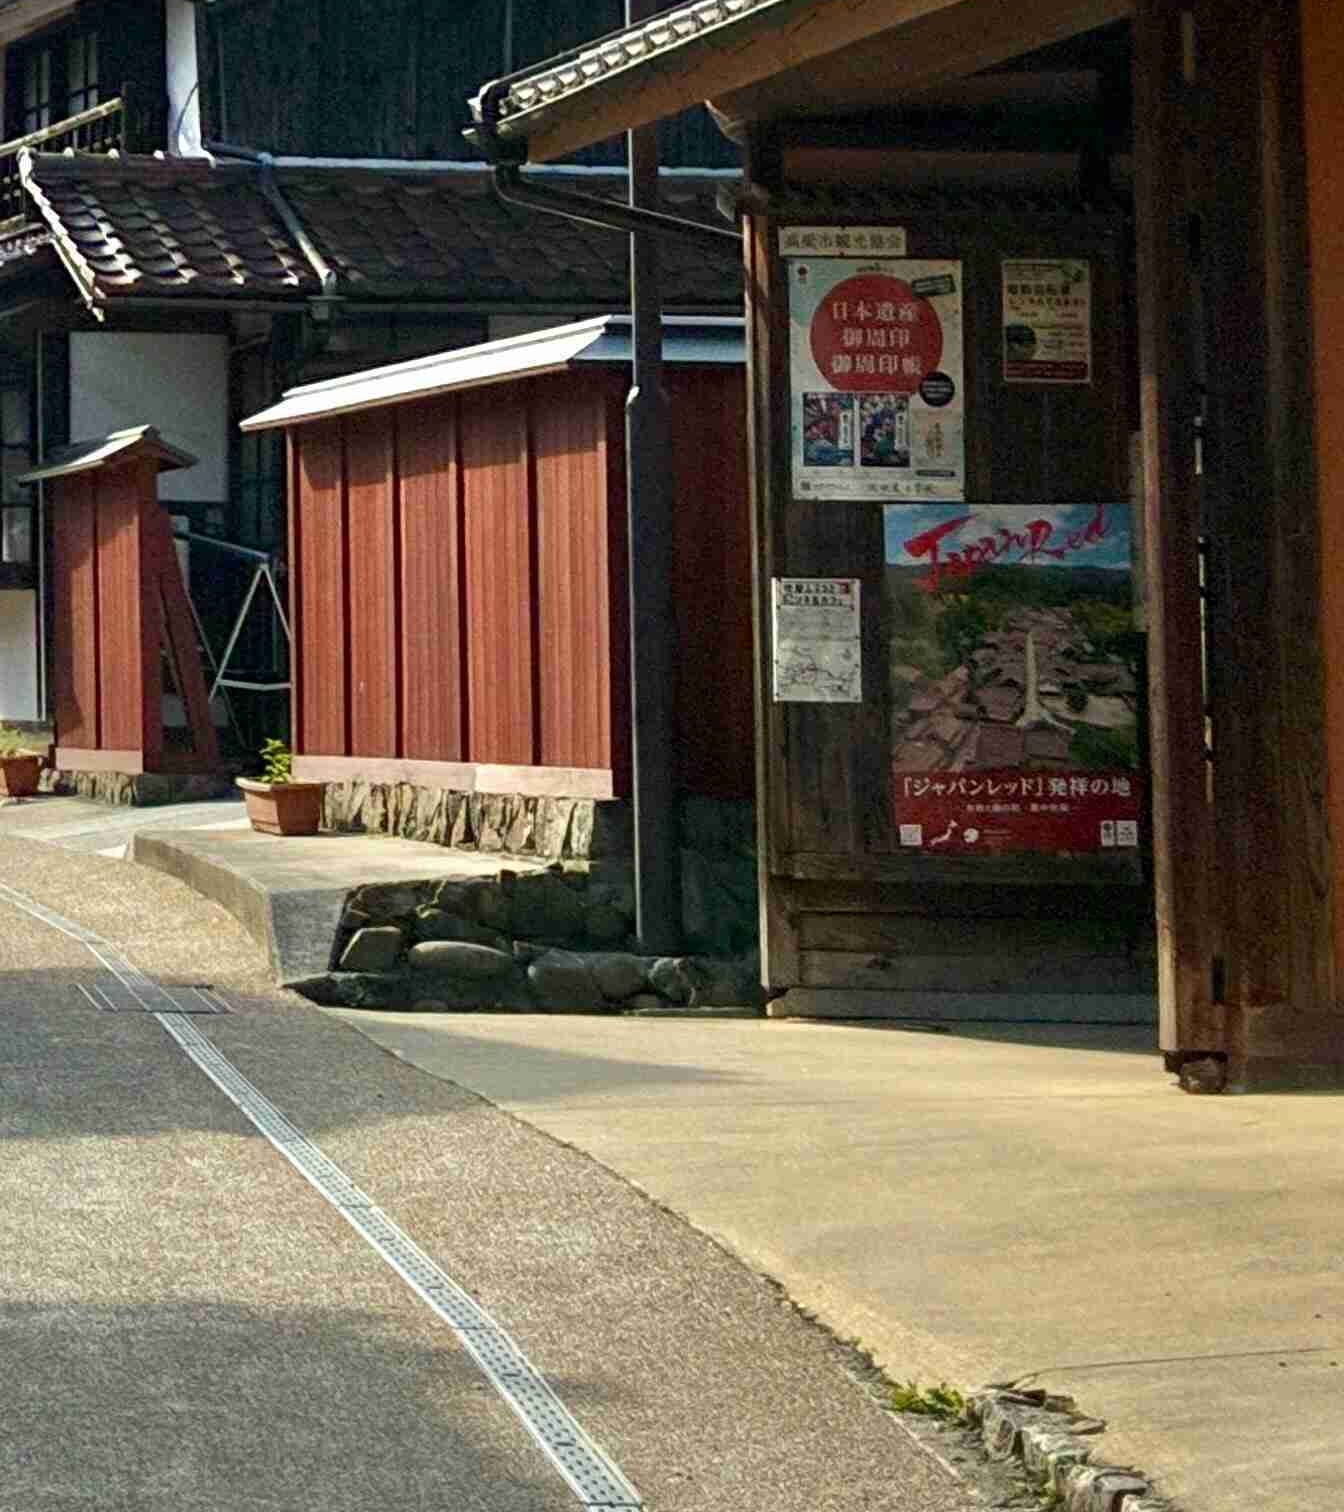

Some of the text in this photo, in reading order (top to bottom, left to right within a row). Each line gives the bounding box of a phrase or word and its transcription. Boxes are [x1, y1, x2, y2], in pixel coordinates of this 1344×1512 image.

[832, 299, 920, 322] 日本遺産
[903, 775, 1132, 798] 「ジャパンレッド」発祥の地
